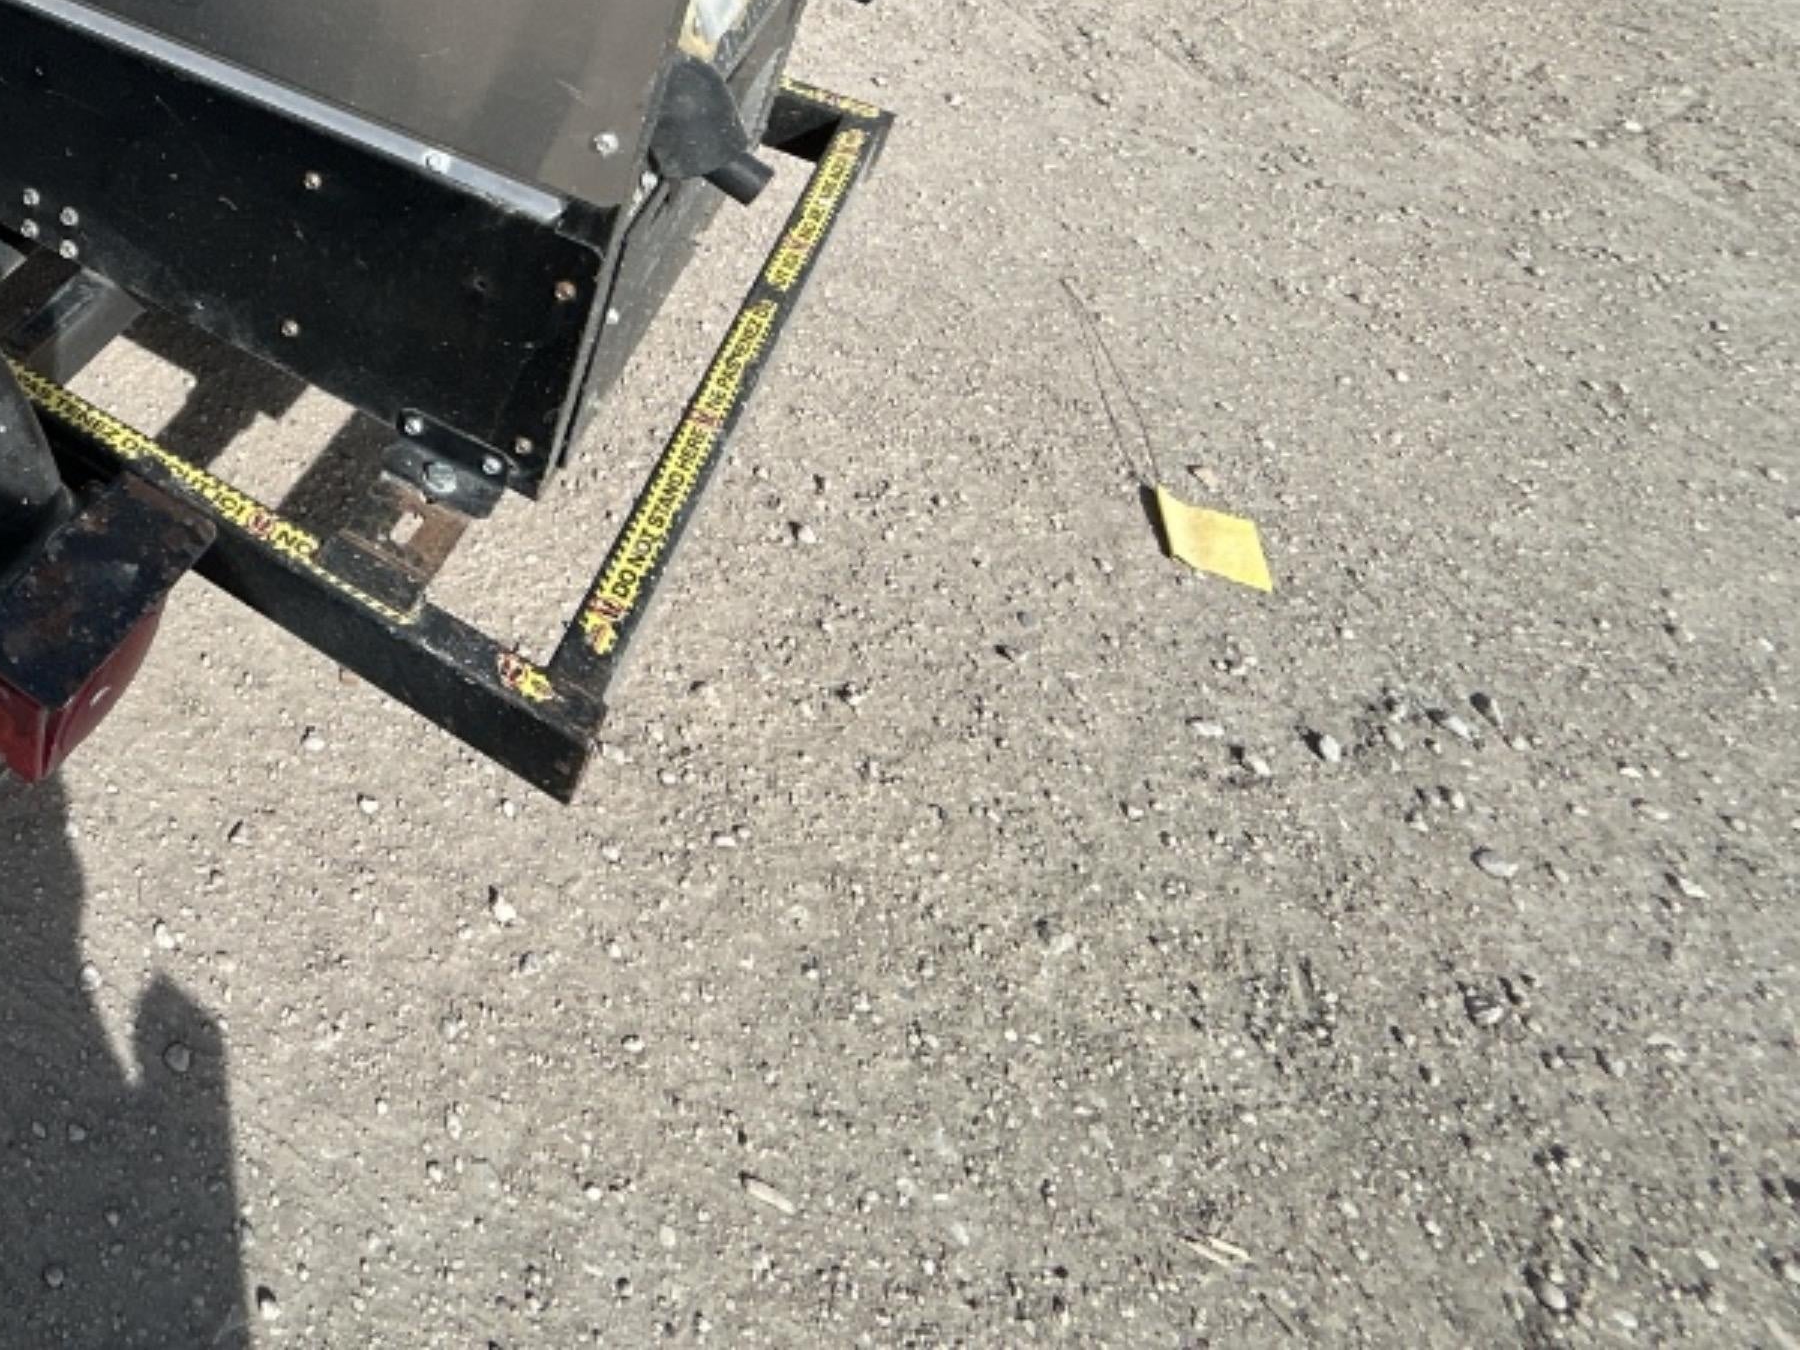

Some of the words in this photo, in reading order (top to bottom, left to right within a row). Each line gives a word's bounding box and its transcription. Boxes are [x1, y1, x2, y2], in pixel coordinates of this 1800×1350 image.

[611, 568, 638, 599] DO
[626, 527, 659, 568] NOT
[647, 469, 685, 528] STAND
[674, 424, 707, 469] HERE
